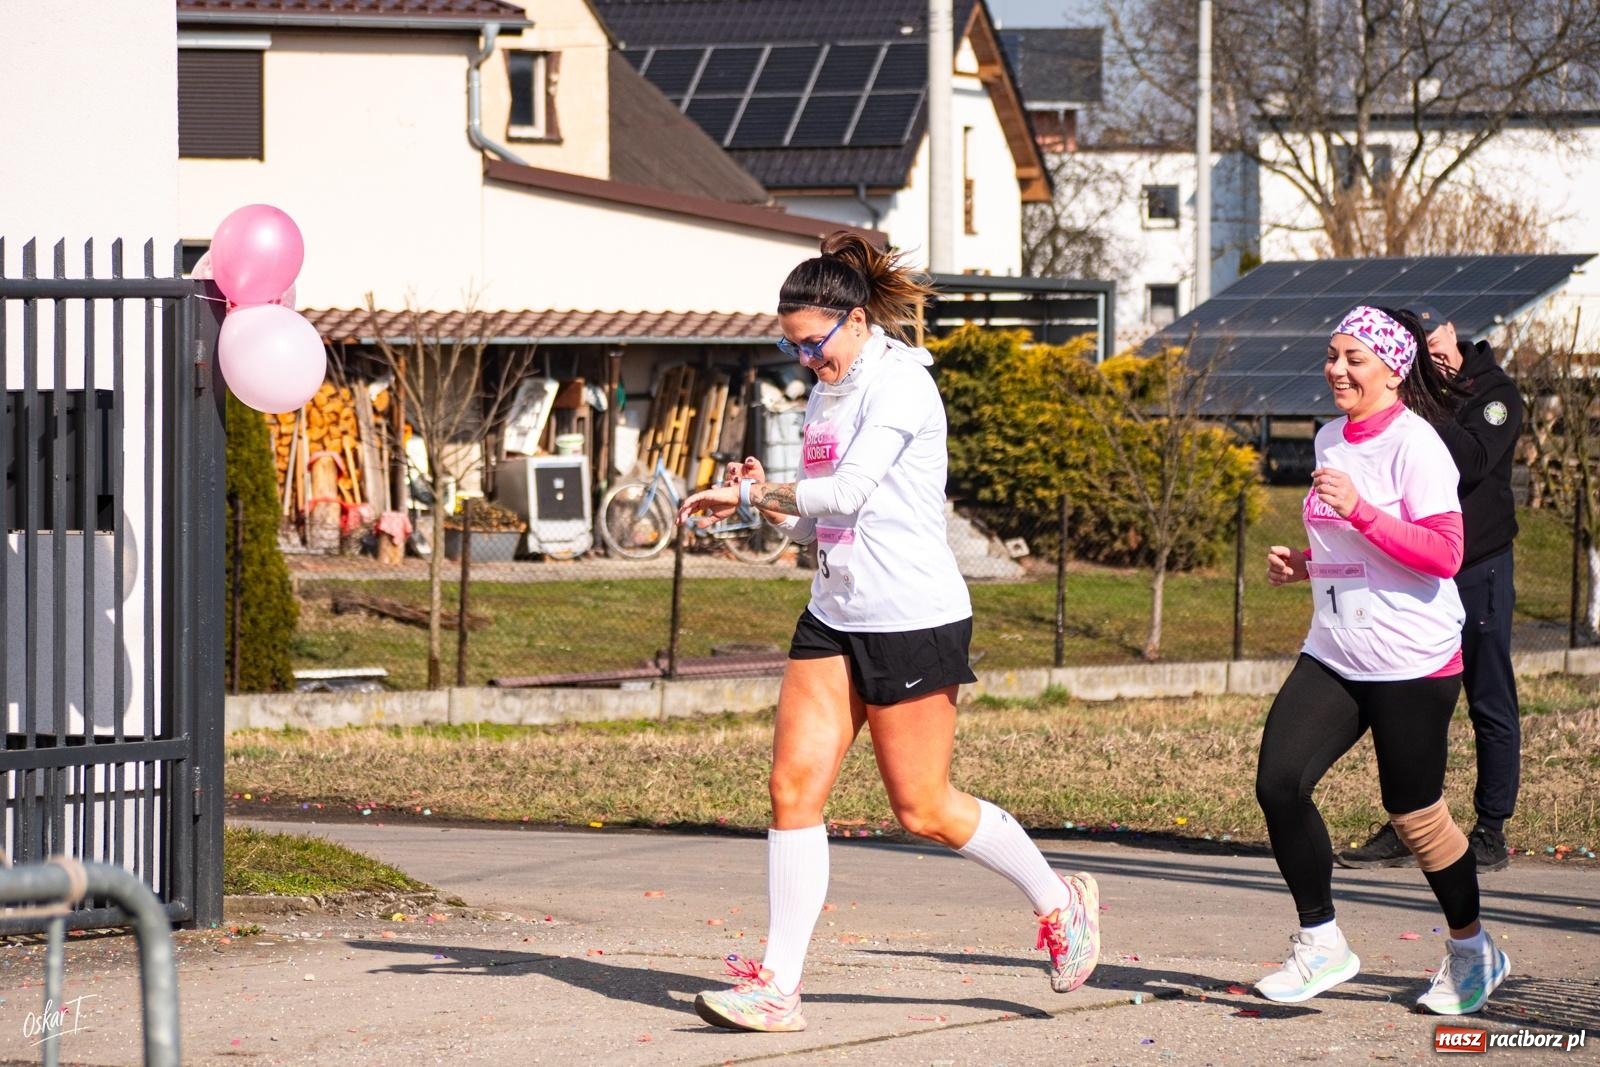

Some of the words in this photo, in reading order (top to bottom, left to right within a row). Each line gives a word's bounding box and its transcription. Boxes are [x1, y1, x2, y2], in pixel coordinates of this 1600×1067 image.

[1313, 502, 1343, 518] KOB
[819, 549, 830, 579] 3
[1326, 585, 1337, 614] 1
